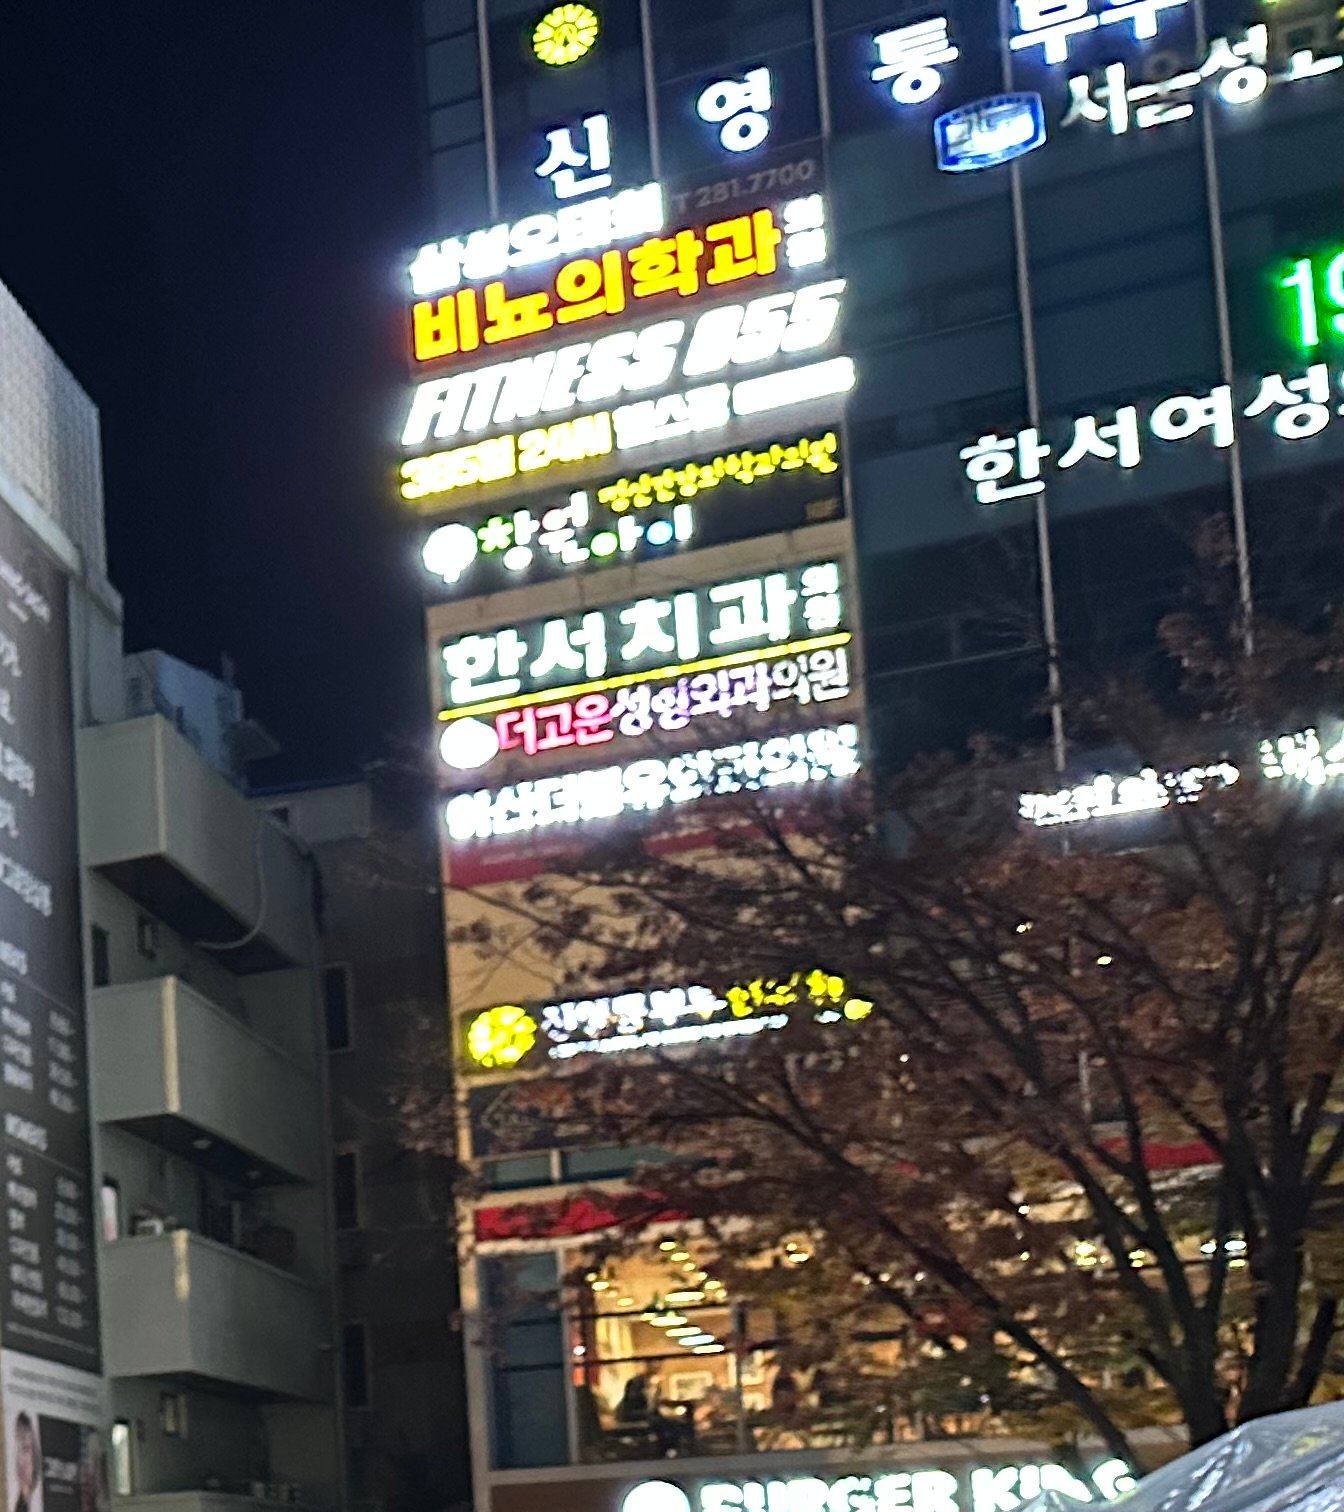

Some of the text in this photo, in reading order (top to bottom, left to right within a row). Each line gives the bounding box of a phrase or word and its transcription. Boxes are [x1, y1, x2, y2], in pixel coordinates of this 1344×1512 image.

[413, 208, 782, 361] 비뇨의학과
[401, 318, 687, 446] FITNESS
[959, 363, 1344, 504] 한서여성
[443, 572, 798, 704] 한서치과
